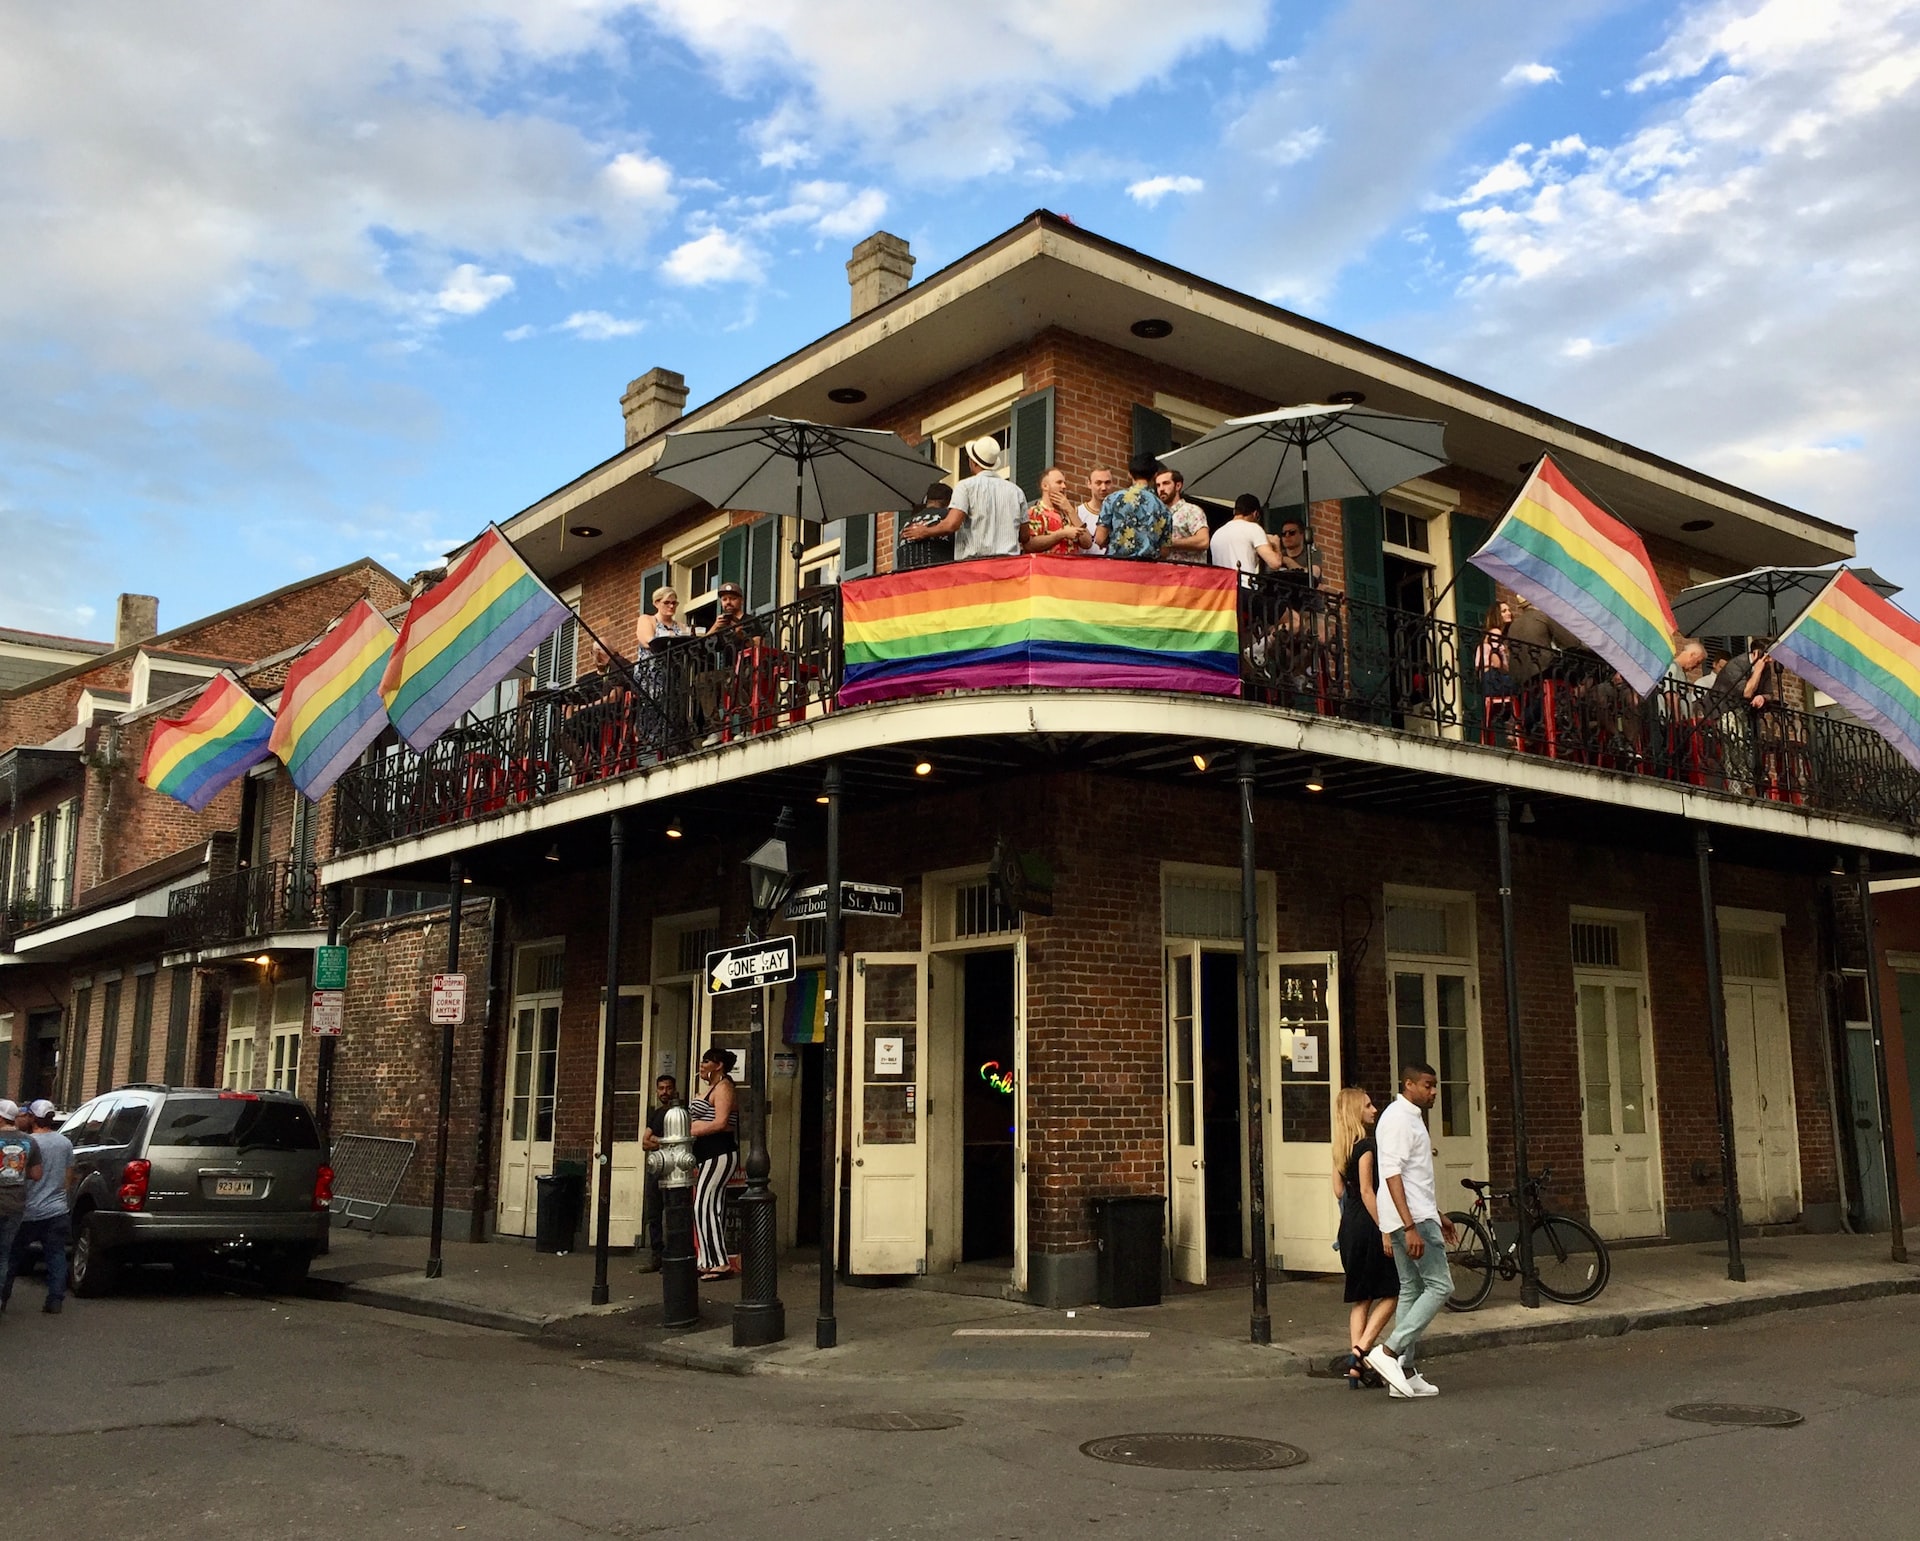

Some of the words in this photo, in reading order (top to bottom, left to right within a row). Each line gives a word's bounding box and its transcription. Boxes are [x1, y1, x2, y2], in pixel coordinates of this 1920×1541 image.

[785, 897, 827, 916] Bourbon
[848, 892, 865, 908] St.
[871, 895, 895, 911] Ann
[434, 978, 443, 988] NO
[218, 1182, 233, 1191] 923
